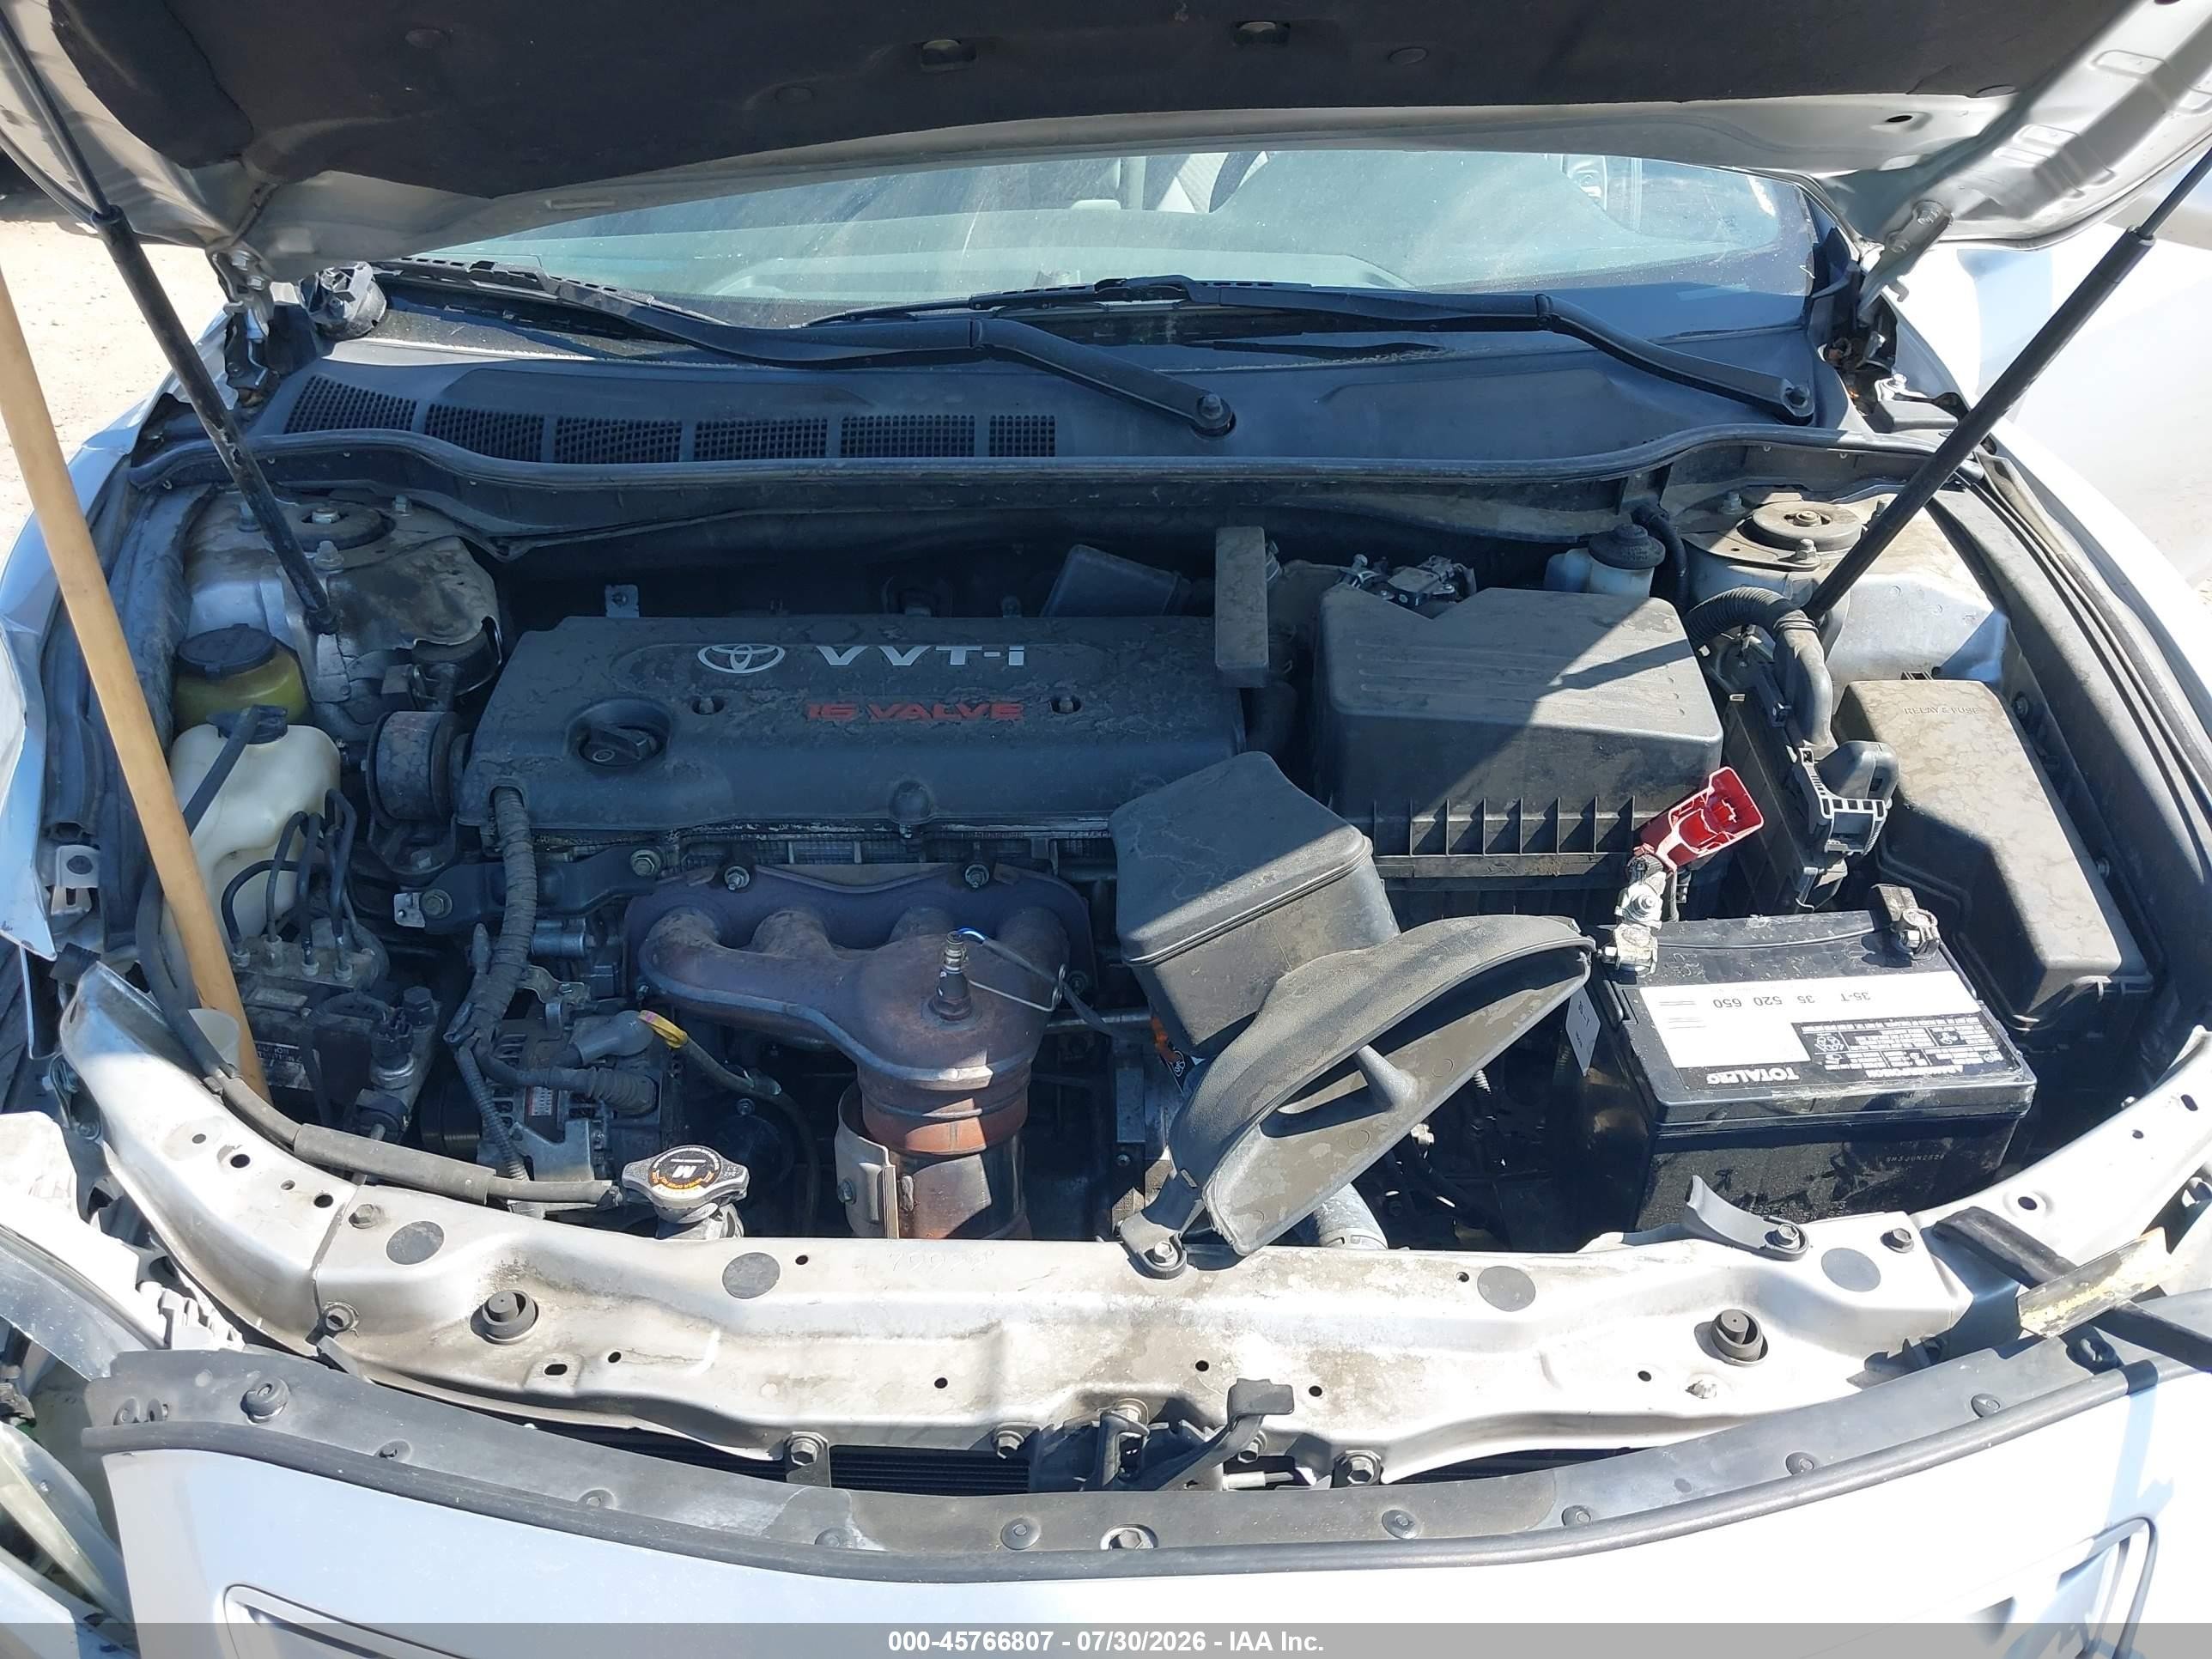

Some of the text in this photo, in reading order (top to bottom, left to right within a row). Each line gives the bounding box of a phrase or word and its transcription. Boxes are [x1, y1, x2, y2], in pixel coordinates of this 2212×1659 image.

[816, 646, 1024, 666] VVT-i
[866, 702, 1024, 722] VALVE
[1904, 706, 1939, 715] RELAY
[1951, 706, 1980, 715] FUSE
[1712, 991, 1871, 1009] 35-T 35 520 650
